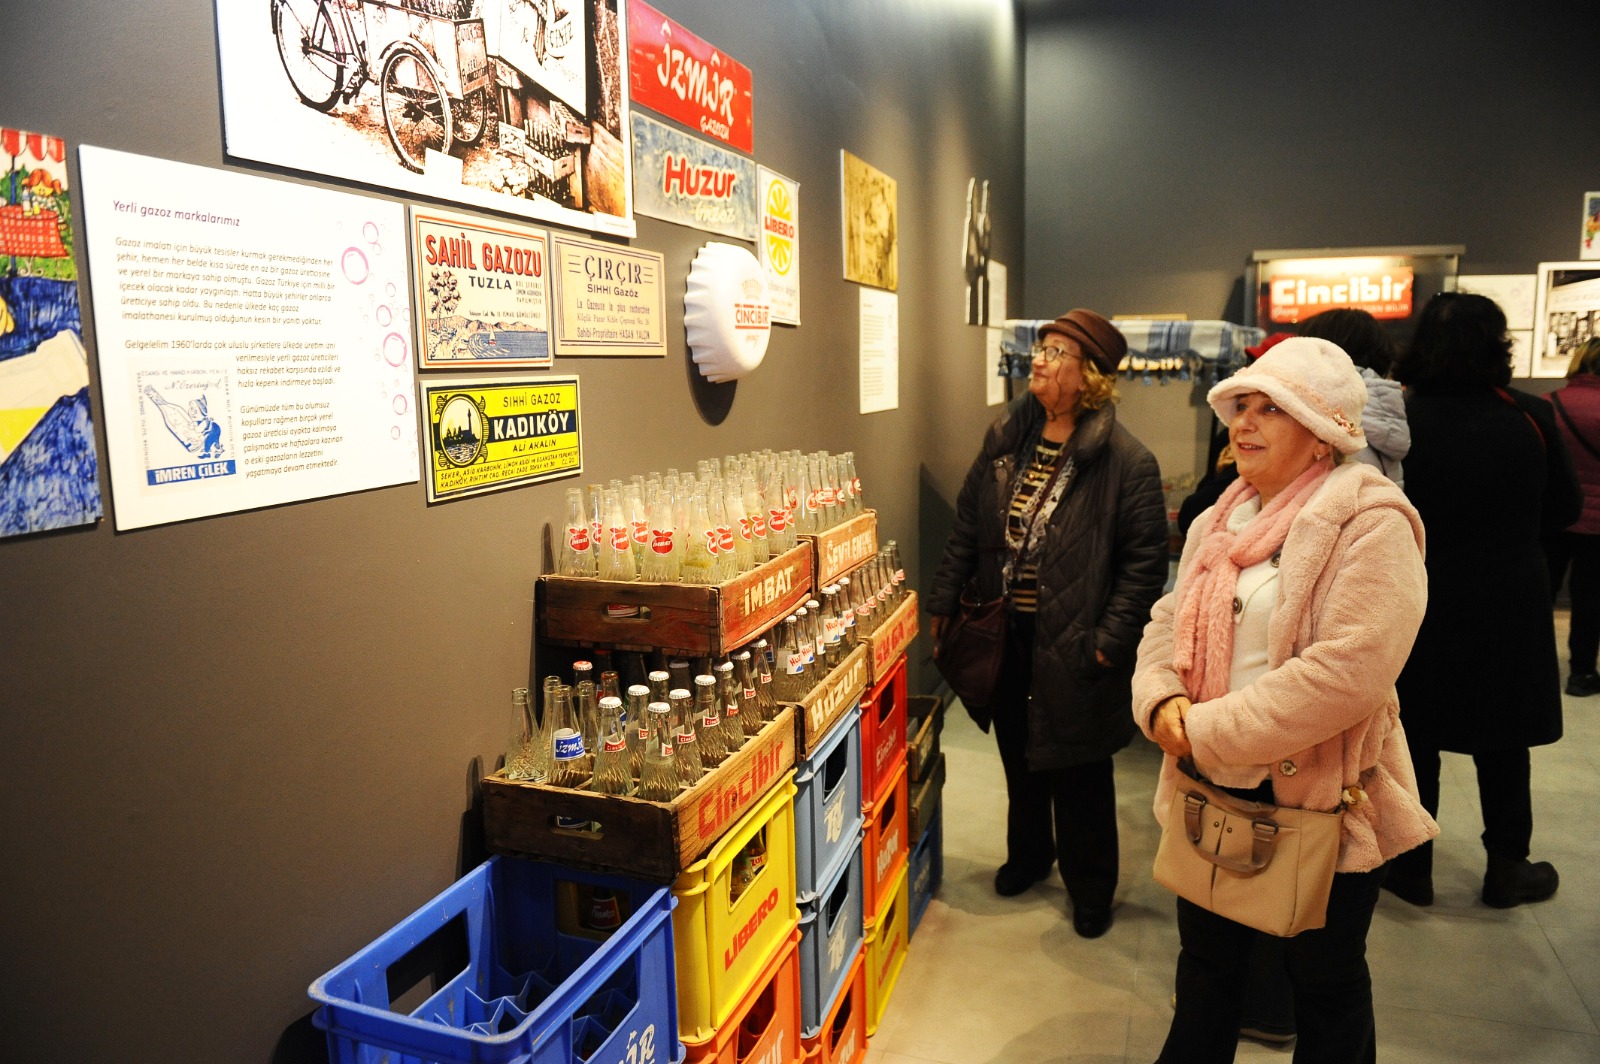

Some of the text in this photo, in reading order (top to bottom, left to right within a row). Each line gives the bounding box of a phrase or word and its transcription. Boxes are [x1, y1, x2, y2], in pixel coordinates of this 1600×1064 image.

[664, 155, 735, 198] Huzur
[113, 200, 240, 226] Yerli gazoz markalarımız
[425, 233, 542, 278] SAHİL GAZOZU
[584, 254, 643, 285] ÇIRÇIR
[468, 275, 512, 290] TUZLA
[1271, 275, 1410, 306] Cincibir
[503, 392, 561, 407] SIHHİ GAZOZ
[494, 408, 569, 440] KADIKÖY
[513, 438, 557, 453] ALİ AKALIN
[155, 462, 229, 483] İMREN ÇİLEK
[744, 565, 794, 617] İMBAT
[811, 659, 862, 732] Huzur
[698, 741, 784, 839] Cincibir
